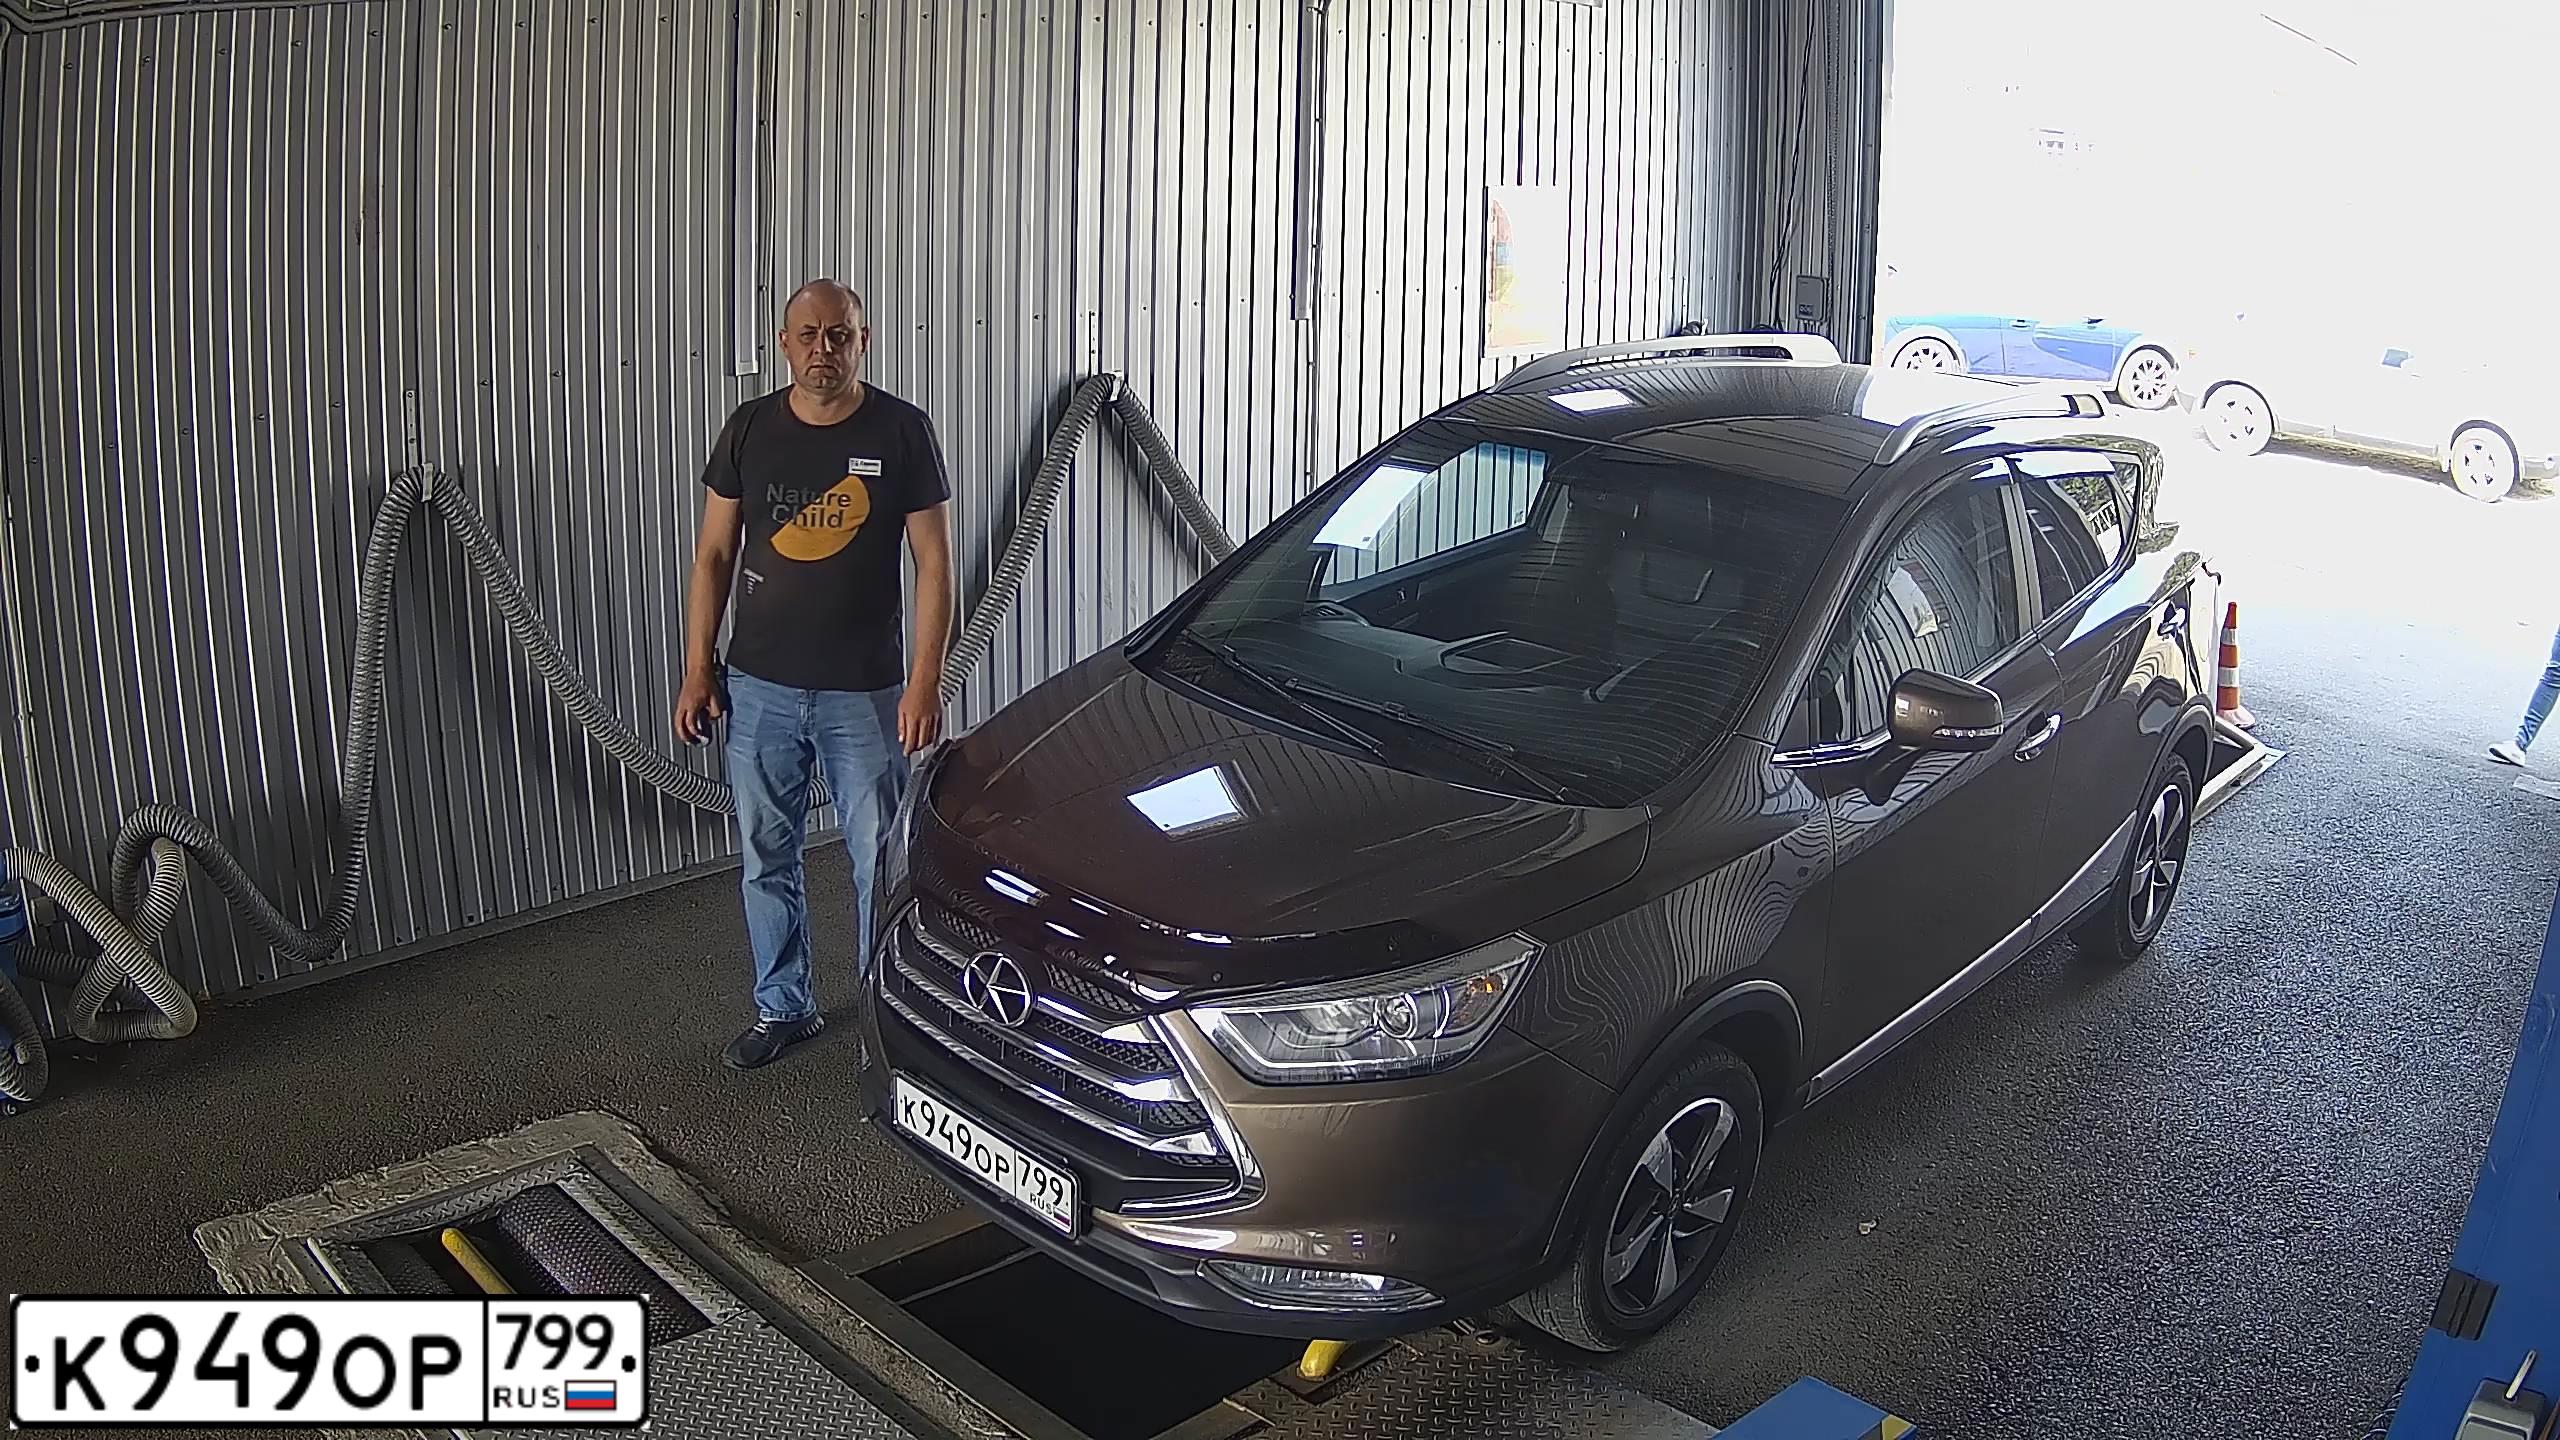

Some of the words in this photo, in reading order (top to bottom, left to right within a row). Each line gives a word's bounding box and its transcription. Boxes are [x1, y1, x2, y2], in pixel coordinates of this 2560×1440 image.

[766, 483, 851, 508] Nature
[772, 504, 844, 529] Child
[1018, 1155, 1063, 1207] 799
[1030, 1192, 1055, 1215] RUS
